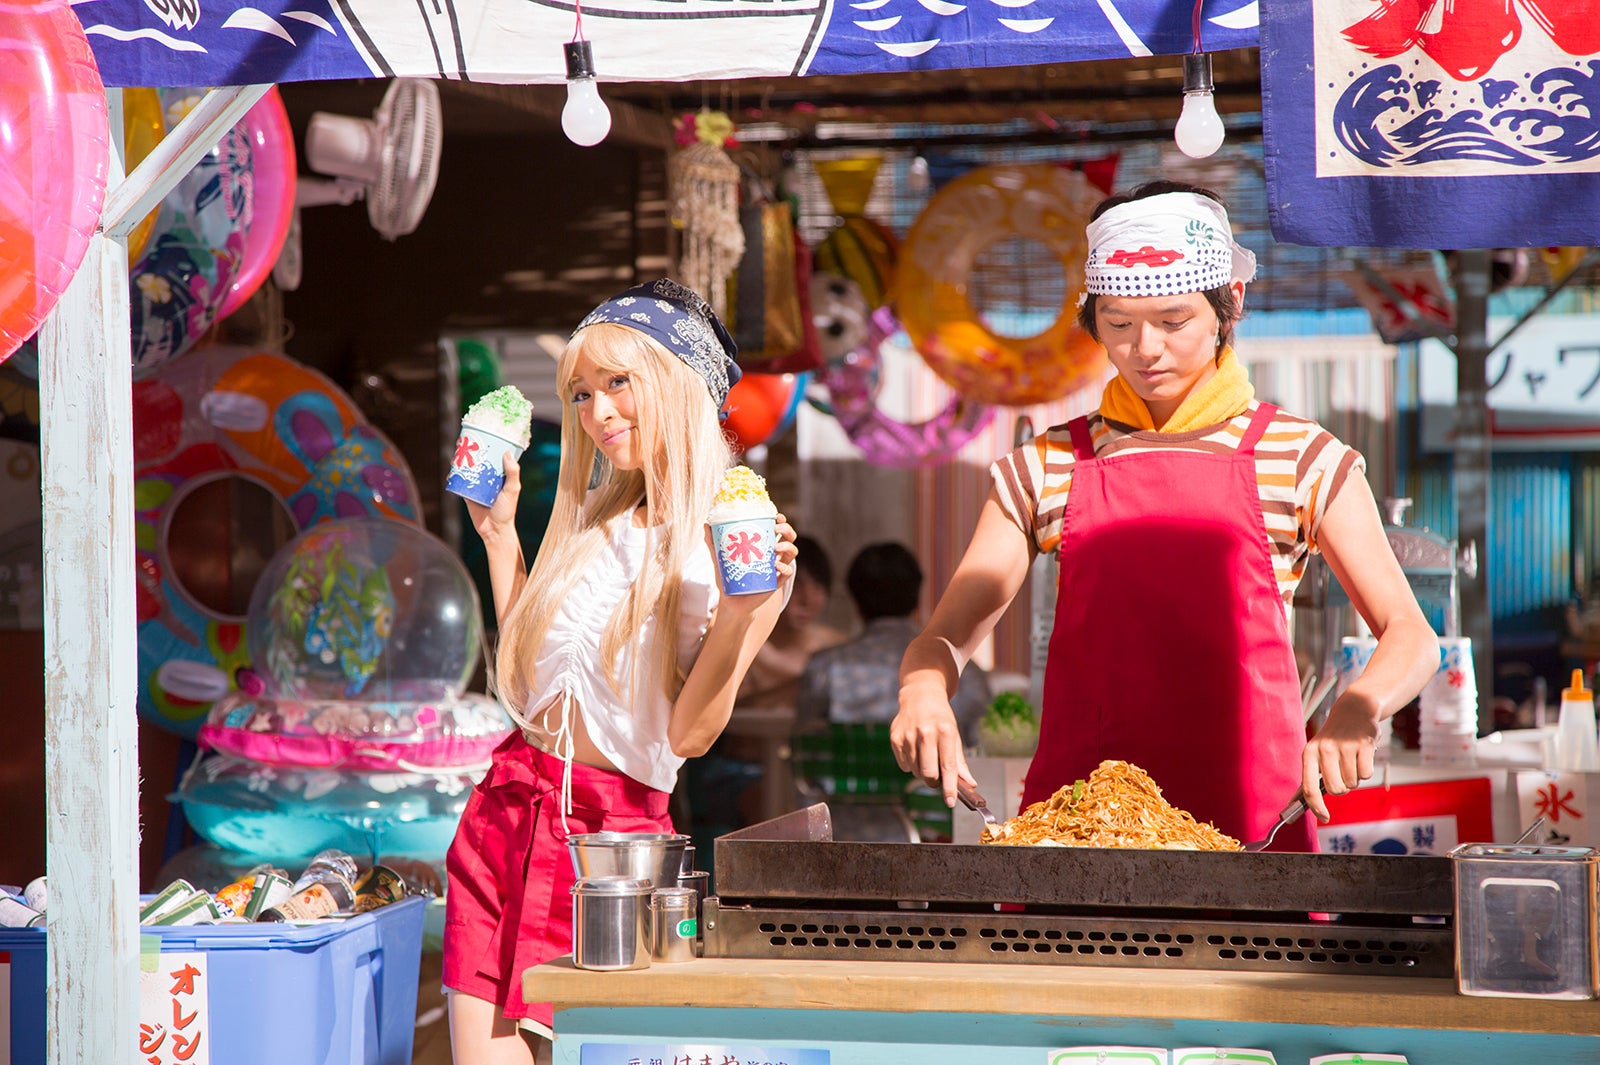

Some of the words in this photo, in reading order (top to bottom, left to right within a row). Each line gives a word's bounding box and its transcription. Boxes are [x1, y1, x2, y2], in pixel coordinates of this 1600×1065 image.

[450, 436, 480, 468] 氷
[725, 531, 764, 565] 氷
[1533, 782, 1584, 823] 氷
[169, 963, 202, 1065] オレン
